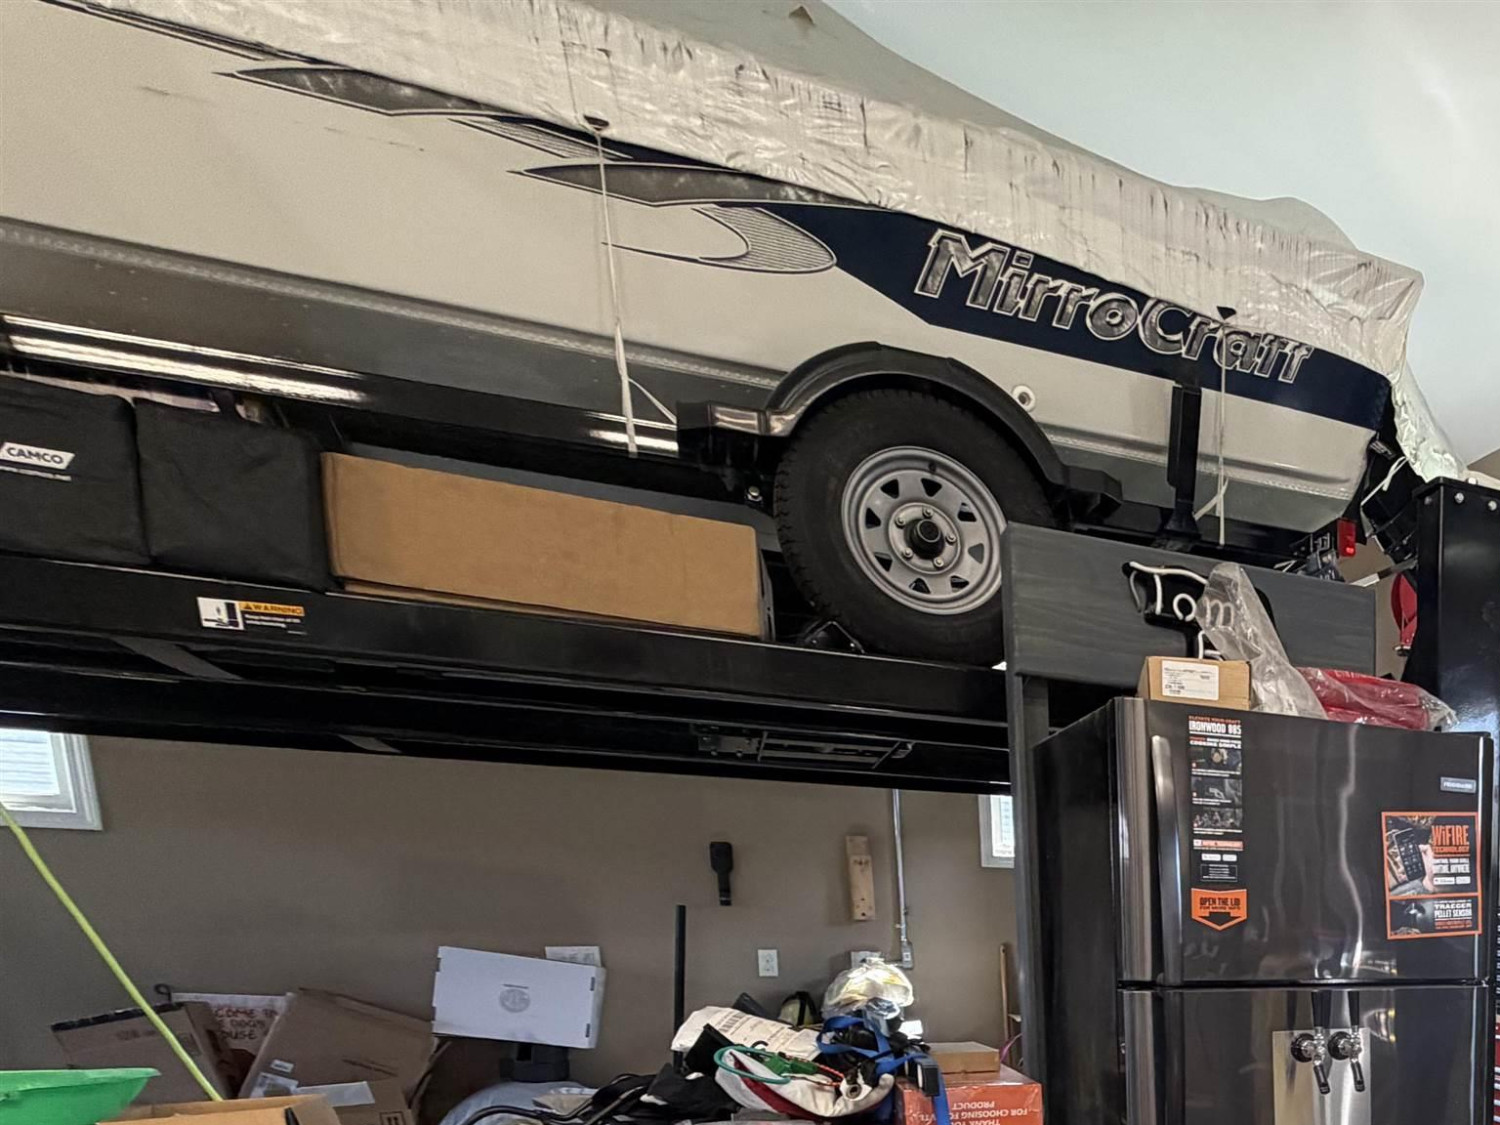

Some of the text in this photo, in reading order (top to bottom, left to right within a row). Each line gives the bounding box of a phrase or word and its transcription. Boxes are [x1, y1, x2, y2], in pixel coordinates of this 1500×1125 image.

[913, 228, 1313, 384] MirroCraft
[7, 447, 64, 464] CAMCO
[253, 603, 302, 615] WARNING
[951, 1101, 995, 1110] PRODUCT
[961, 1109, 1008, 1119] CHOOSING
[1010, 1108, 1028, 1116] FOR
